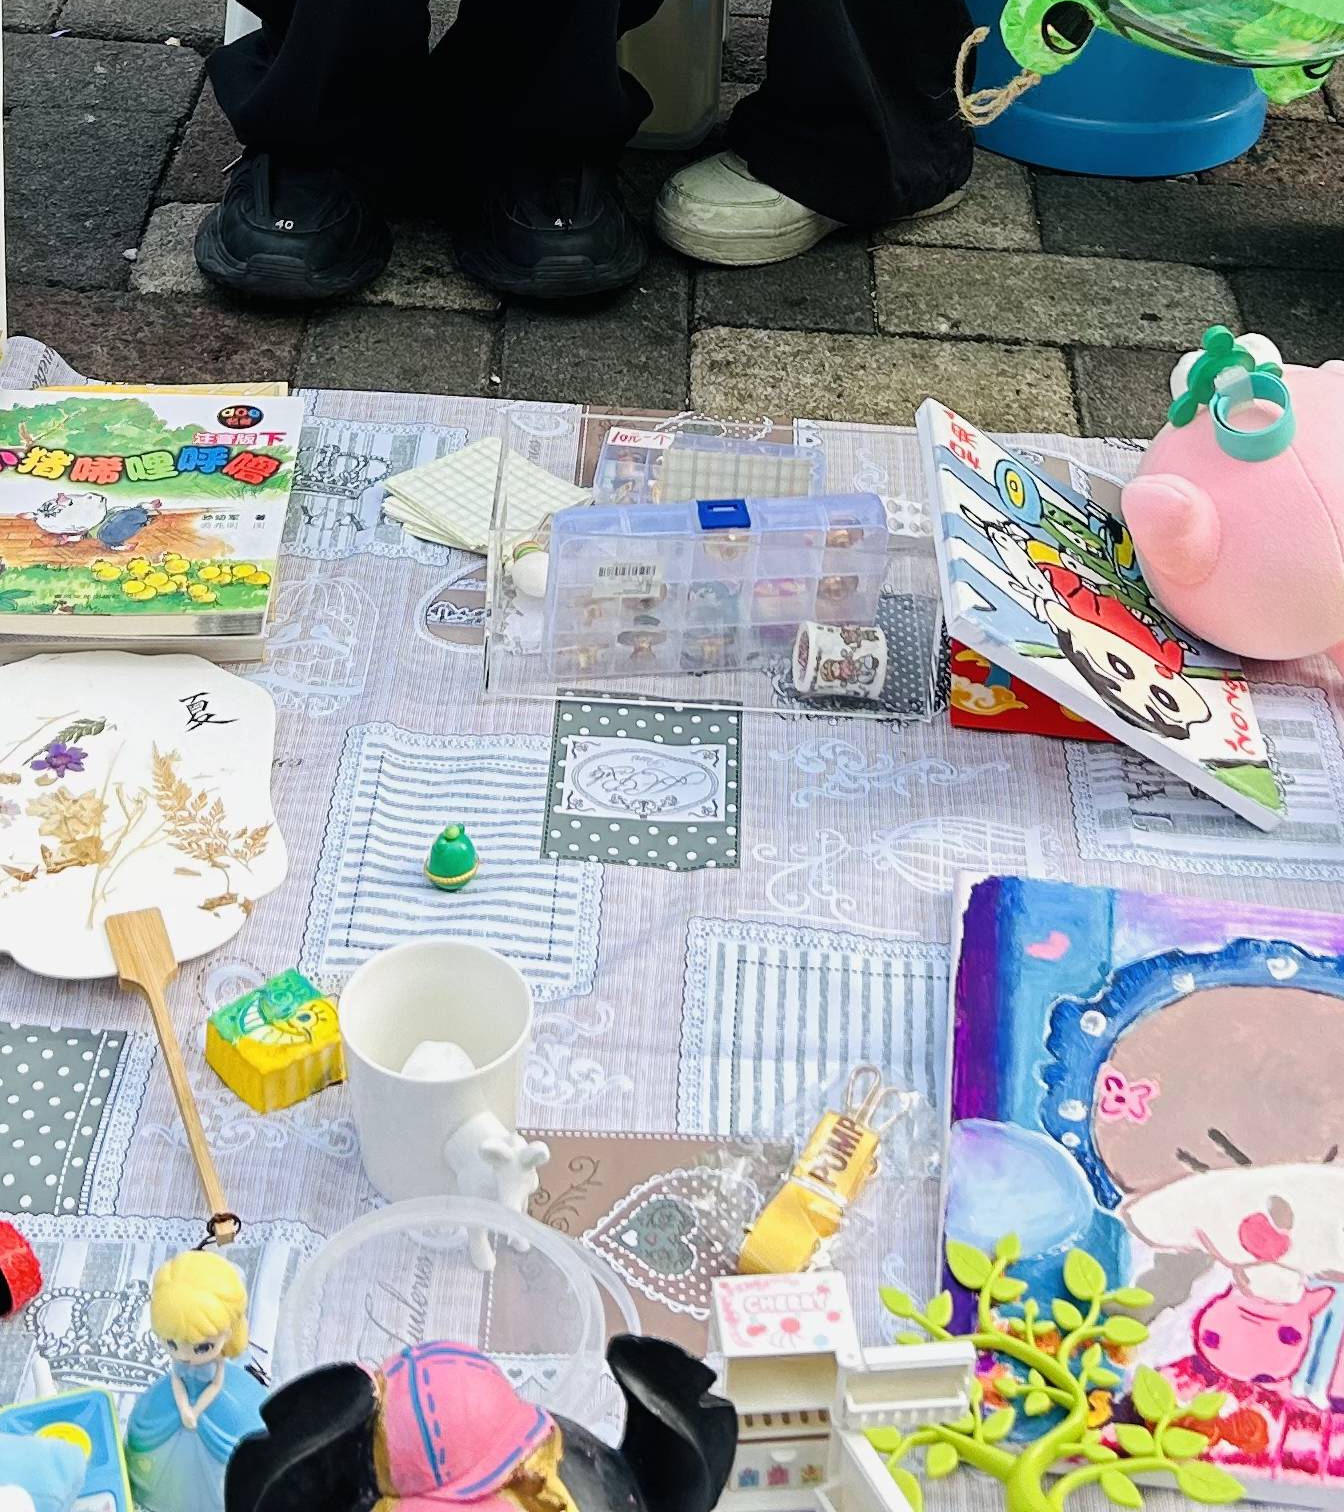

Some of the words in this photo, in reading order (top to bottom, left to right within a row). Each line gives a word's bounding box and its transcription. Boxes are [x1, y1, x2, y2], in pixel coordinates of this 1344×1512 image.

[273, 218, 294, 230] 40
[259, 431, 288, 447] 下
[180, 691, 241, 733] 夏
